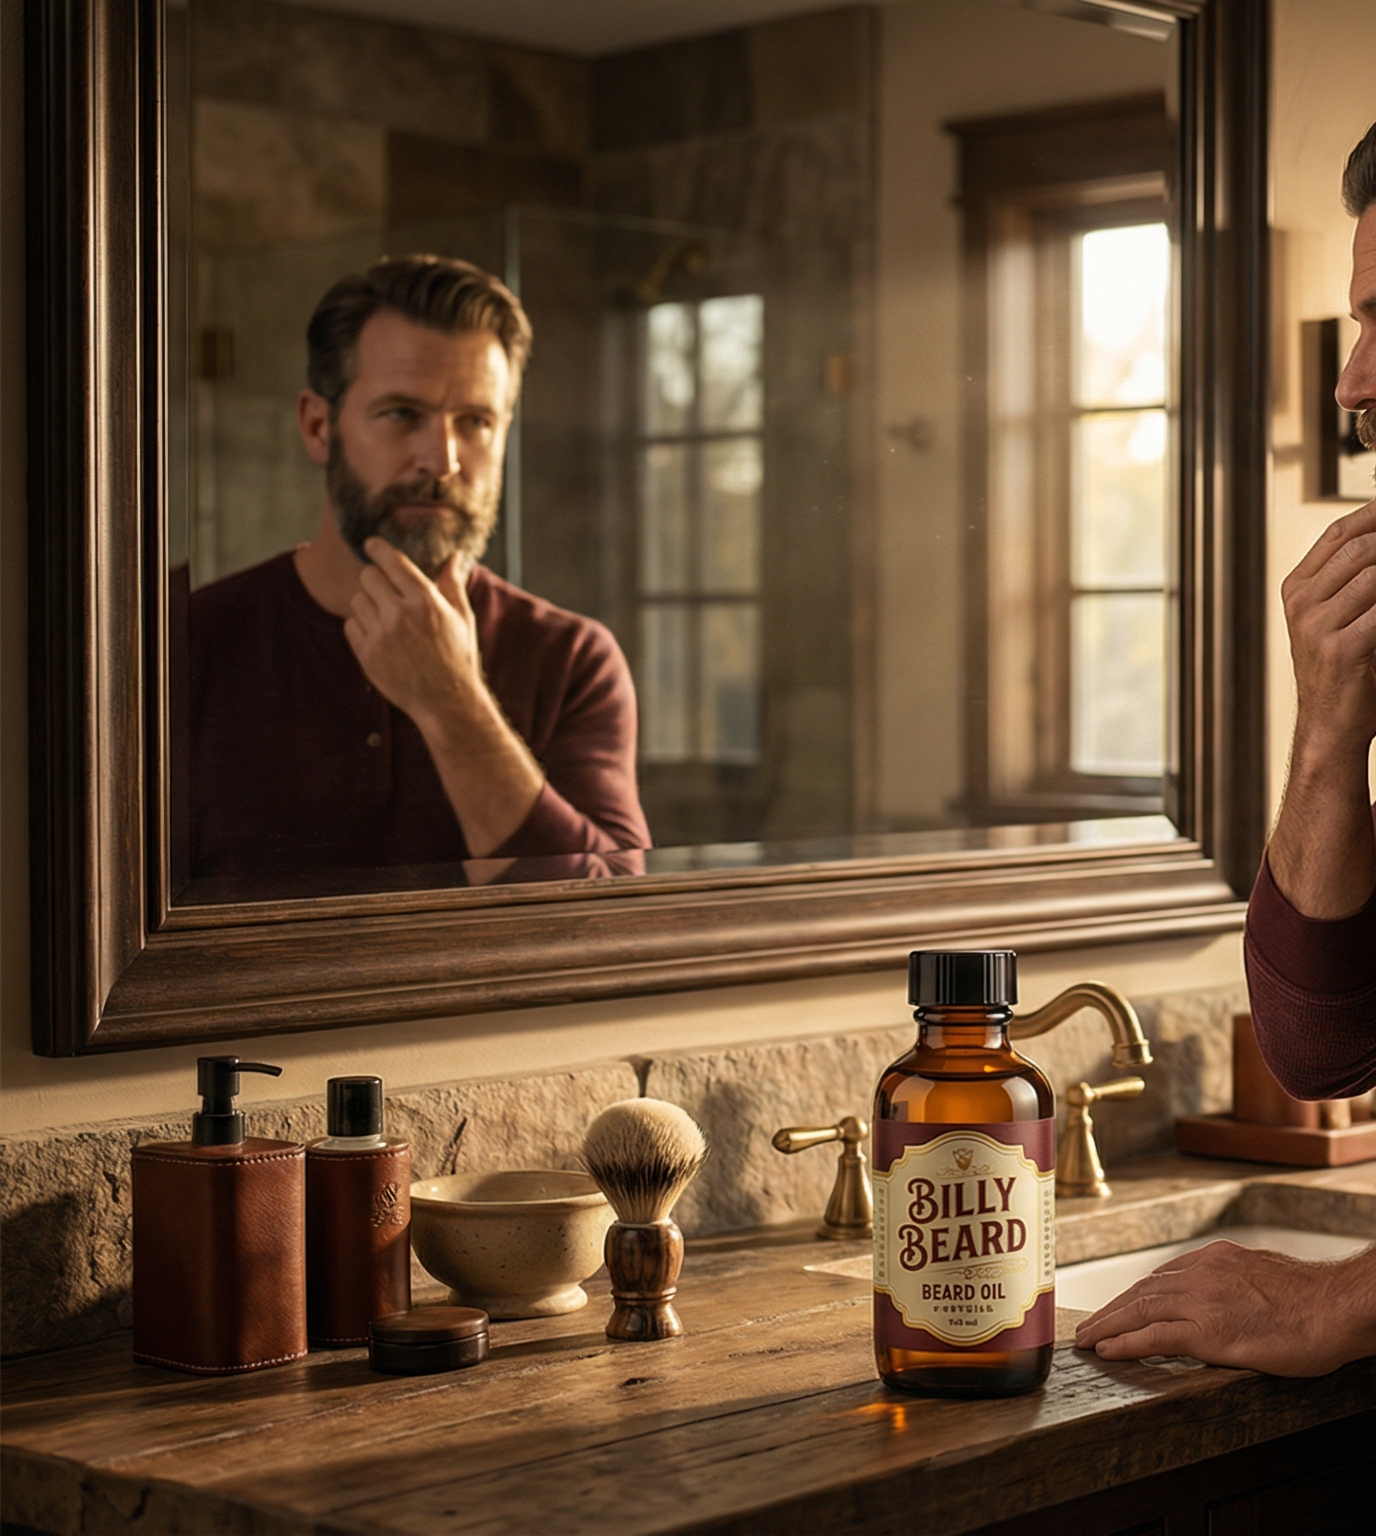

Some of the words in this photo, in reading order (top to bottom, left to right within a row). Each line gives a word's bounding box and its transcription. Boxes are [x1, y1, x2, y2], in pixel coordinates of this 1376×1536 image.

[907, 1177, 1017, 1224] BILLY
[898, 1219, 1027, 1271] BEARD
[922, 1283, 975, 1300] BEARD
[981, 1283, 1006, 1300] OIL
